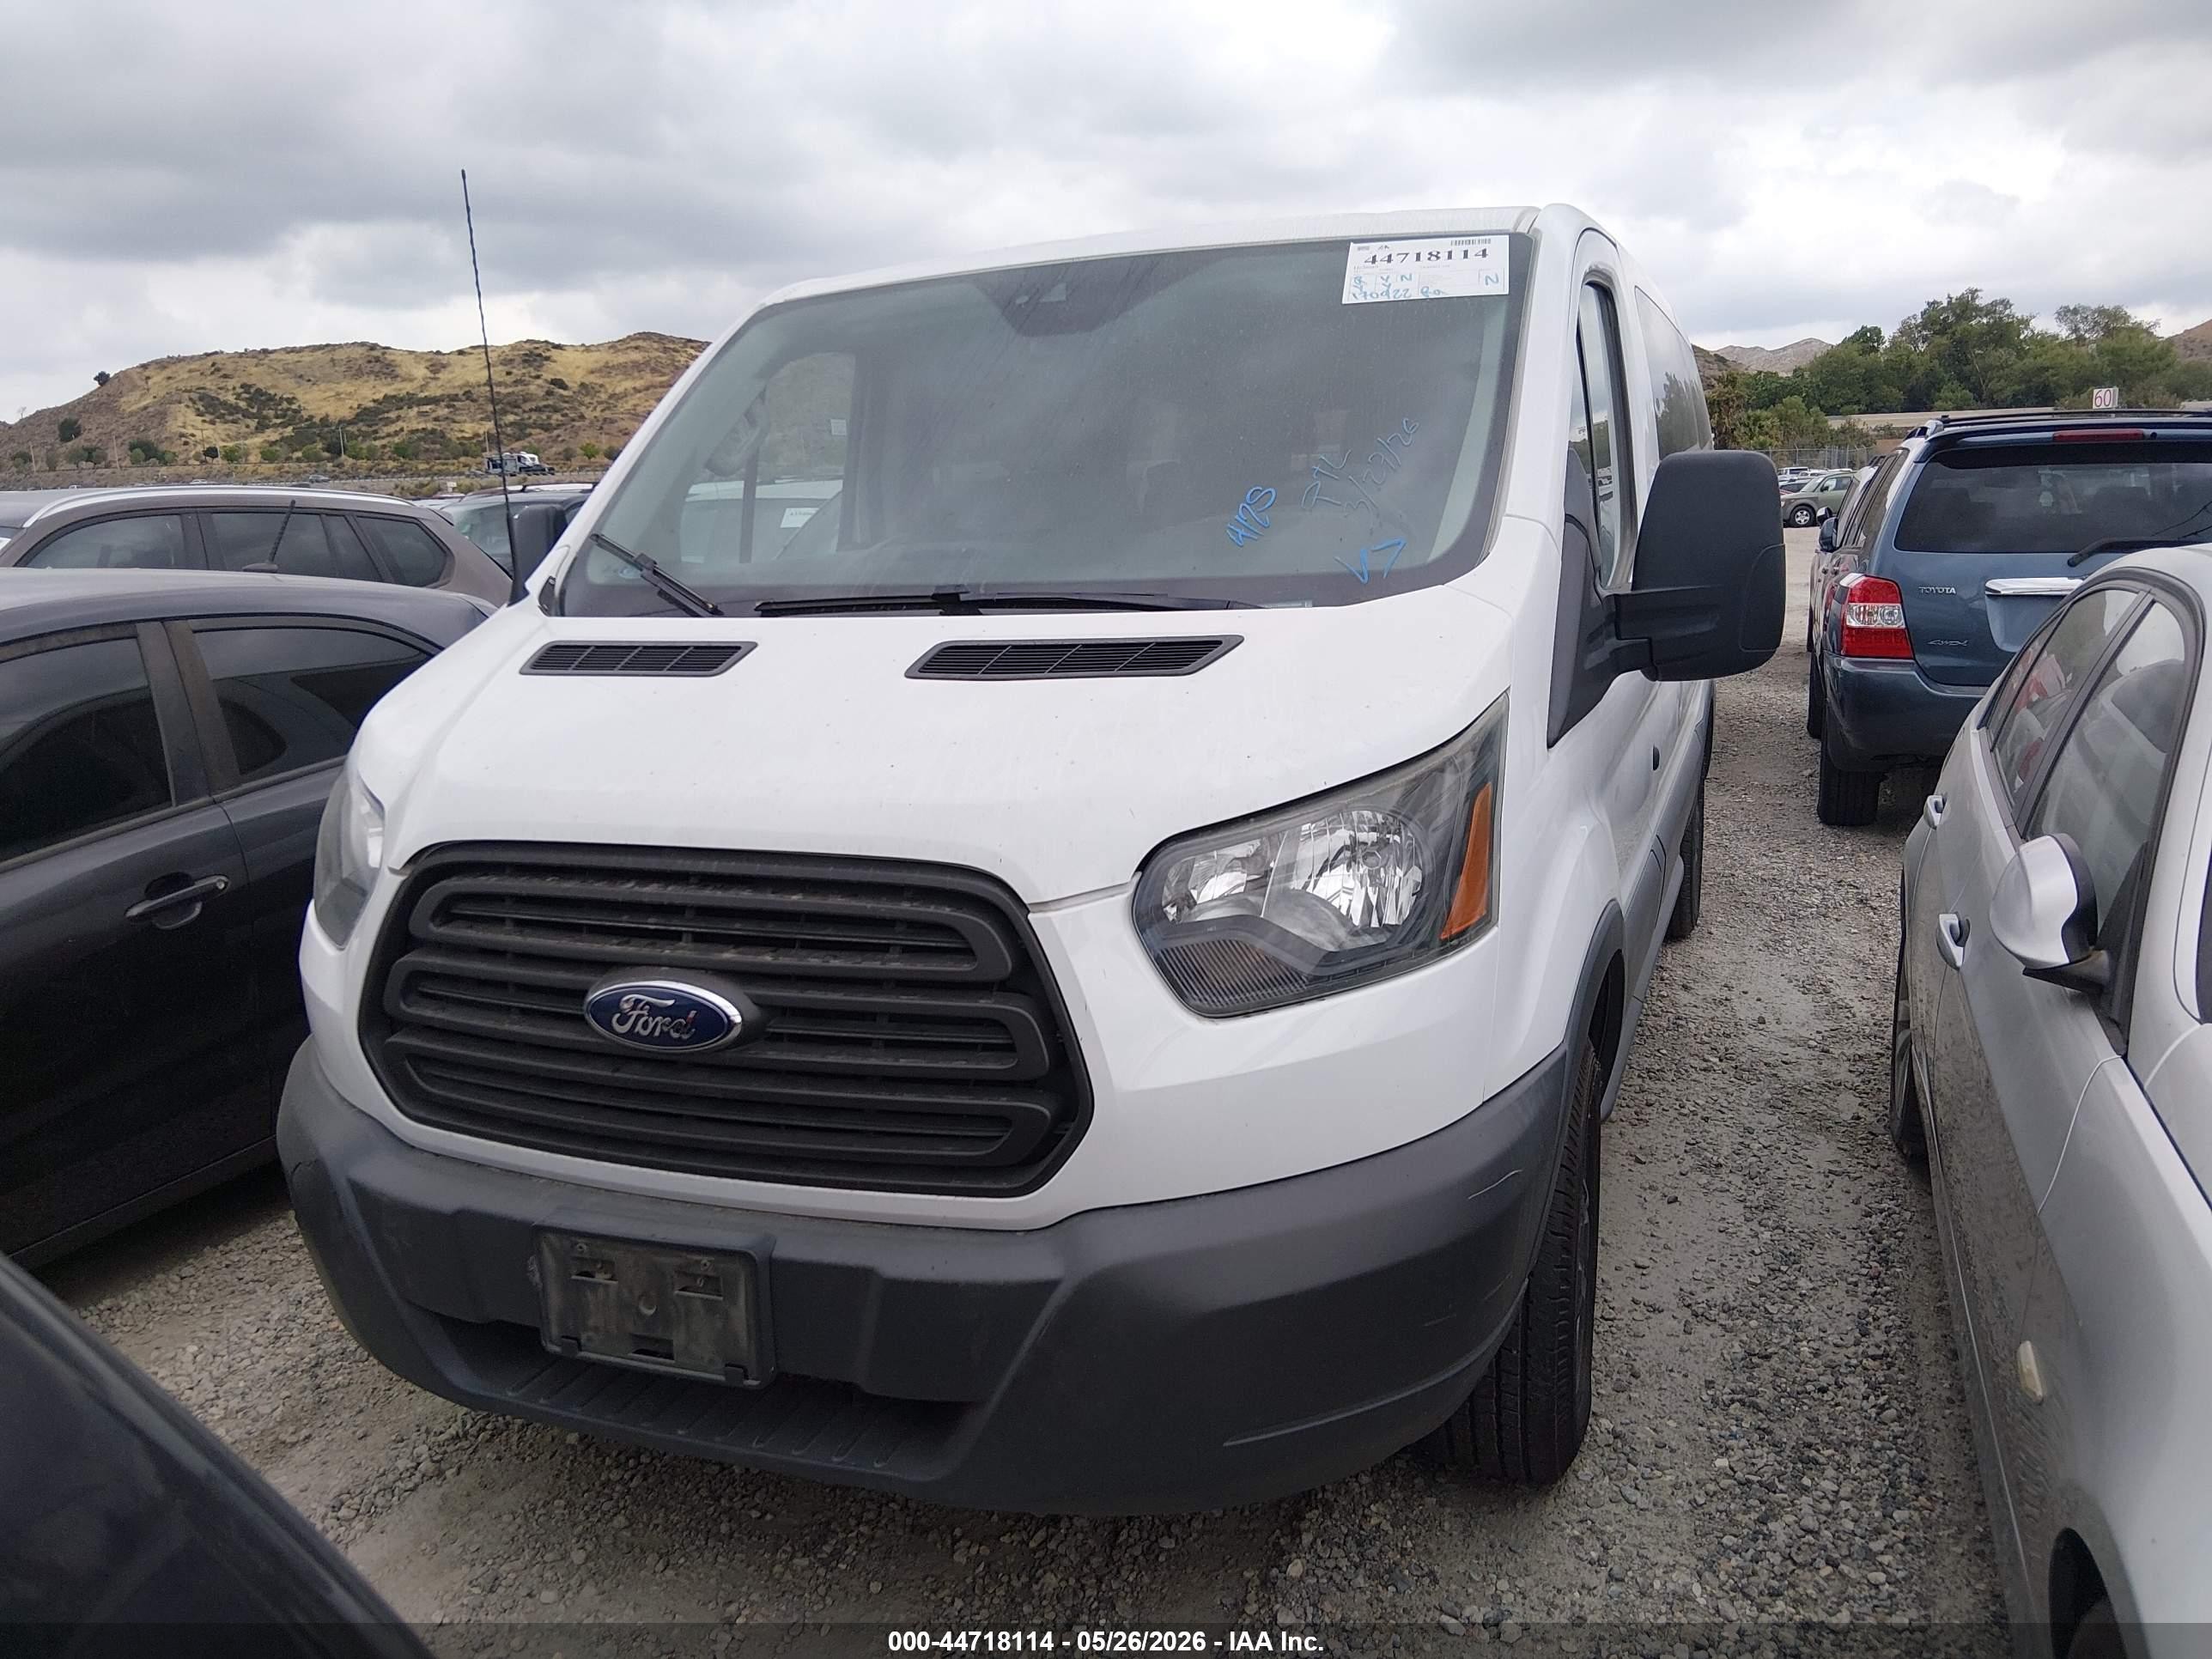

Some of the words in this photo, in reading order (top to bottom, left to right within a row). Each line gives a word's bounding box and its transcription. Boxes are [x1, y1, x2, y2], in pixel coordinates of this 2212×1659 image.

[1364, 248, 1488, 265] 44718114
[2094, 389, 2112, 408] 60
[1918, 586, 1957, 594] TOYOTA
[611, 994, 697, 1040] Ford
